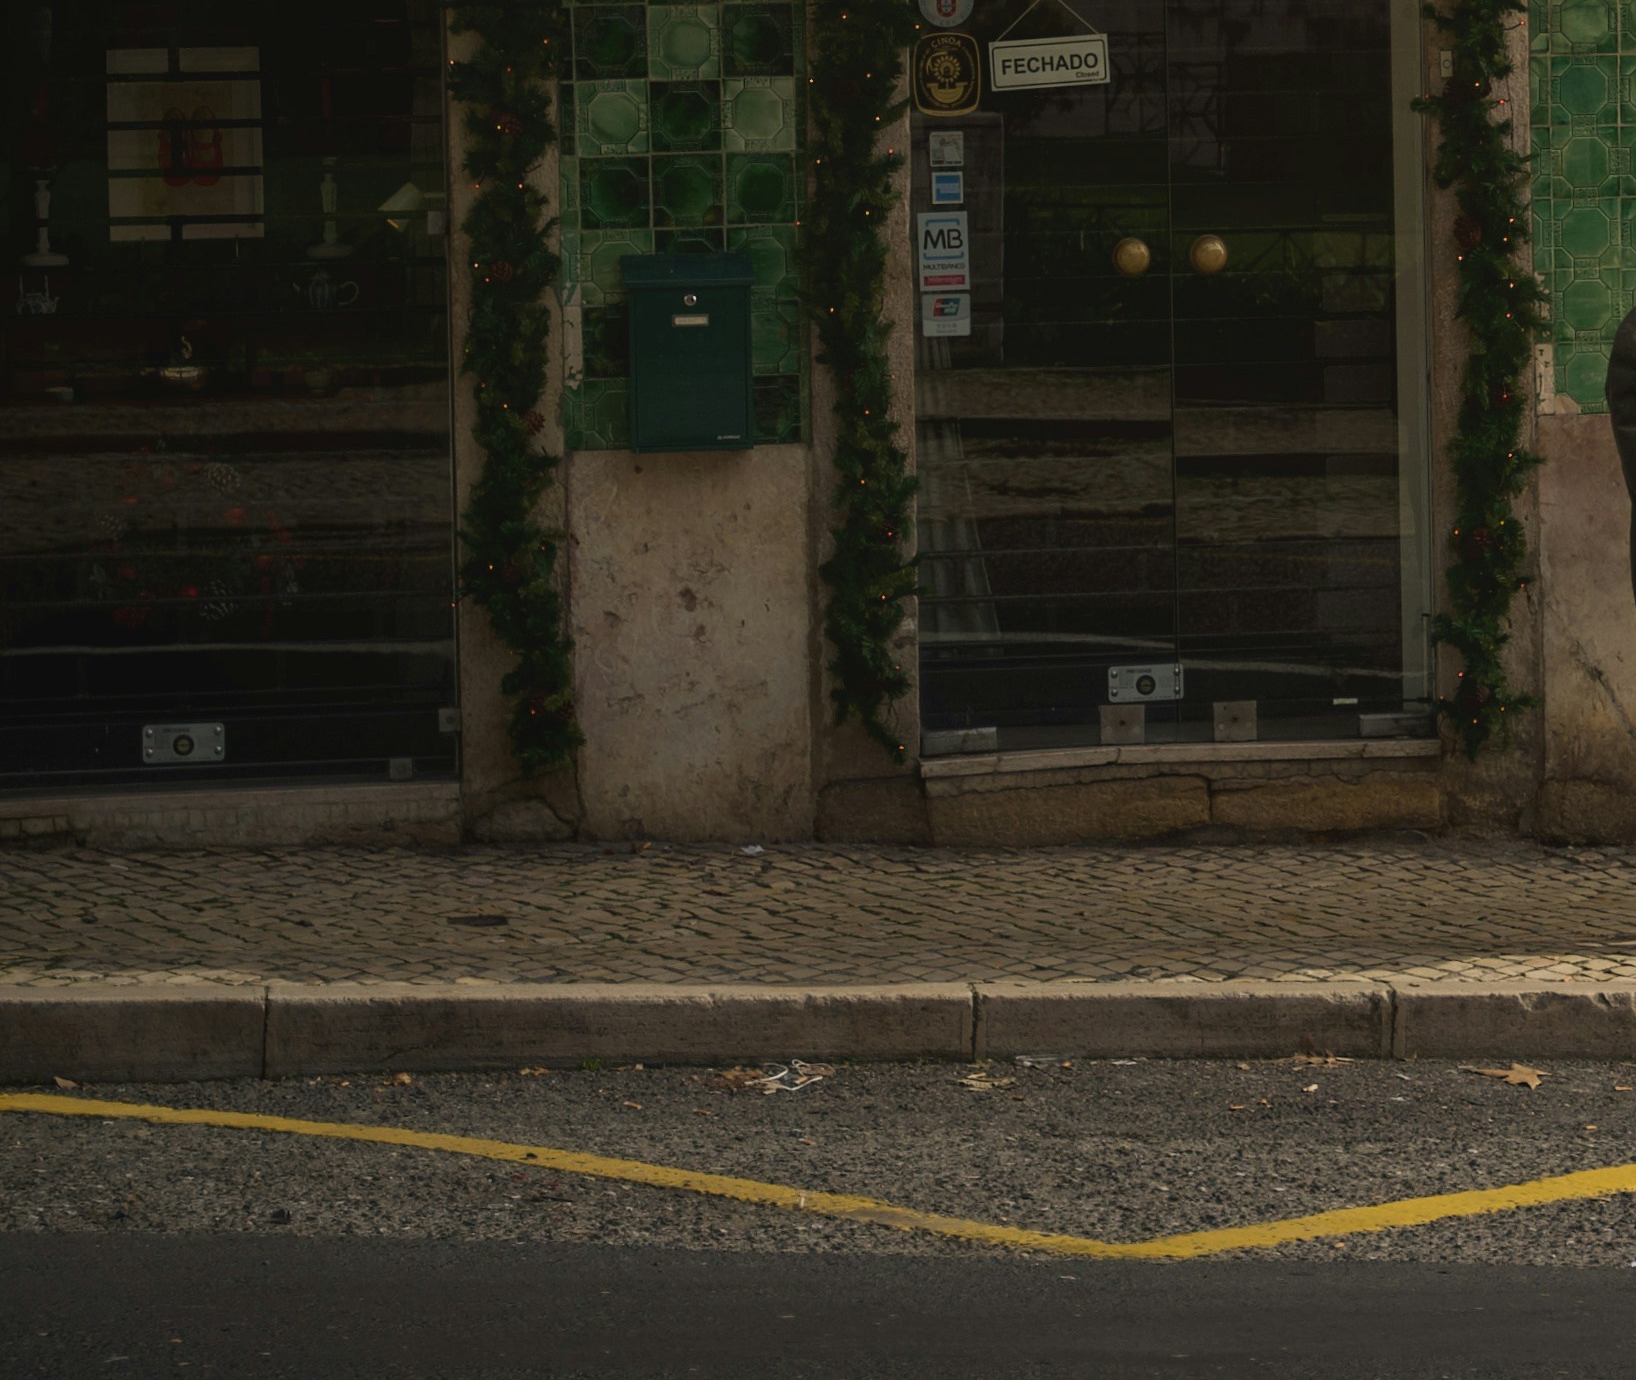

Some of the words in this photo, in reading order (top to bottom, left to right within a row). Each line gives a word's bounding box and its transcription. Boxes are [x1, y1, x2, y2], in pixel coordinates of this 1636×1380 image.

[930, 36, 962, 49] CINOA
[1001, 52, 1098, 76] FECHADO
[1075, 70, 1100, 79] Closed
[923, 228, 963, 251] MB
